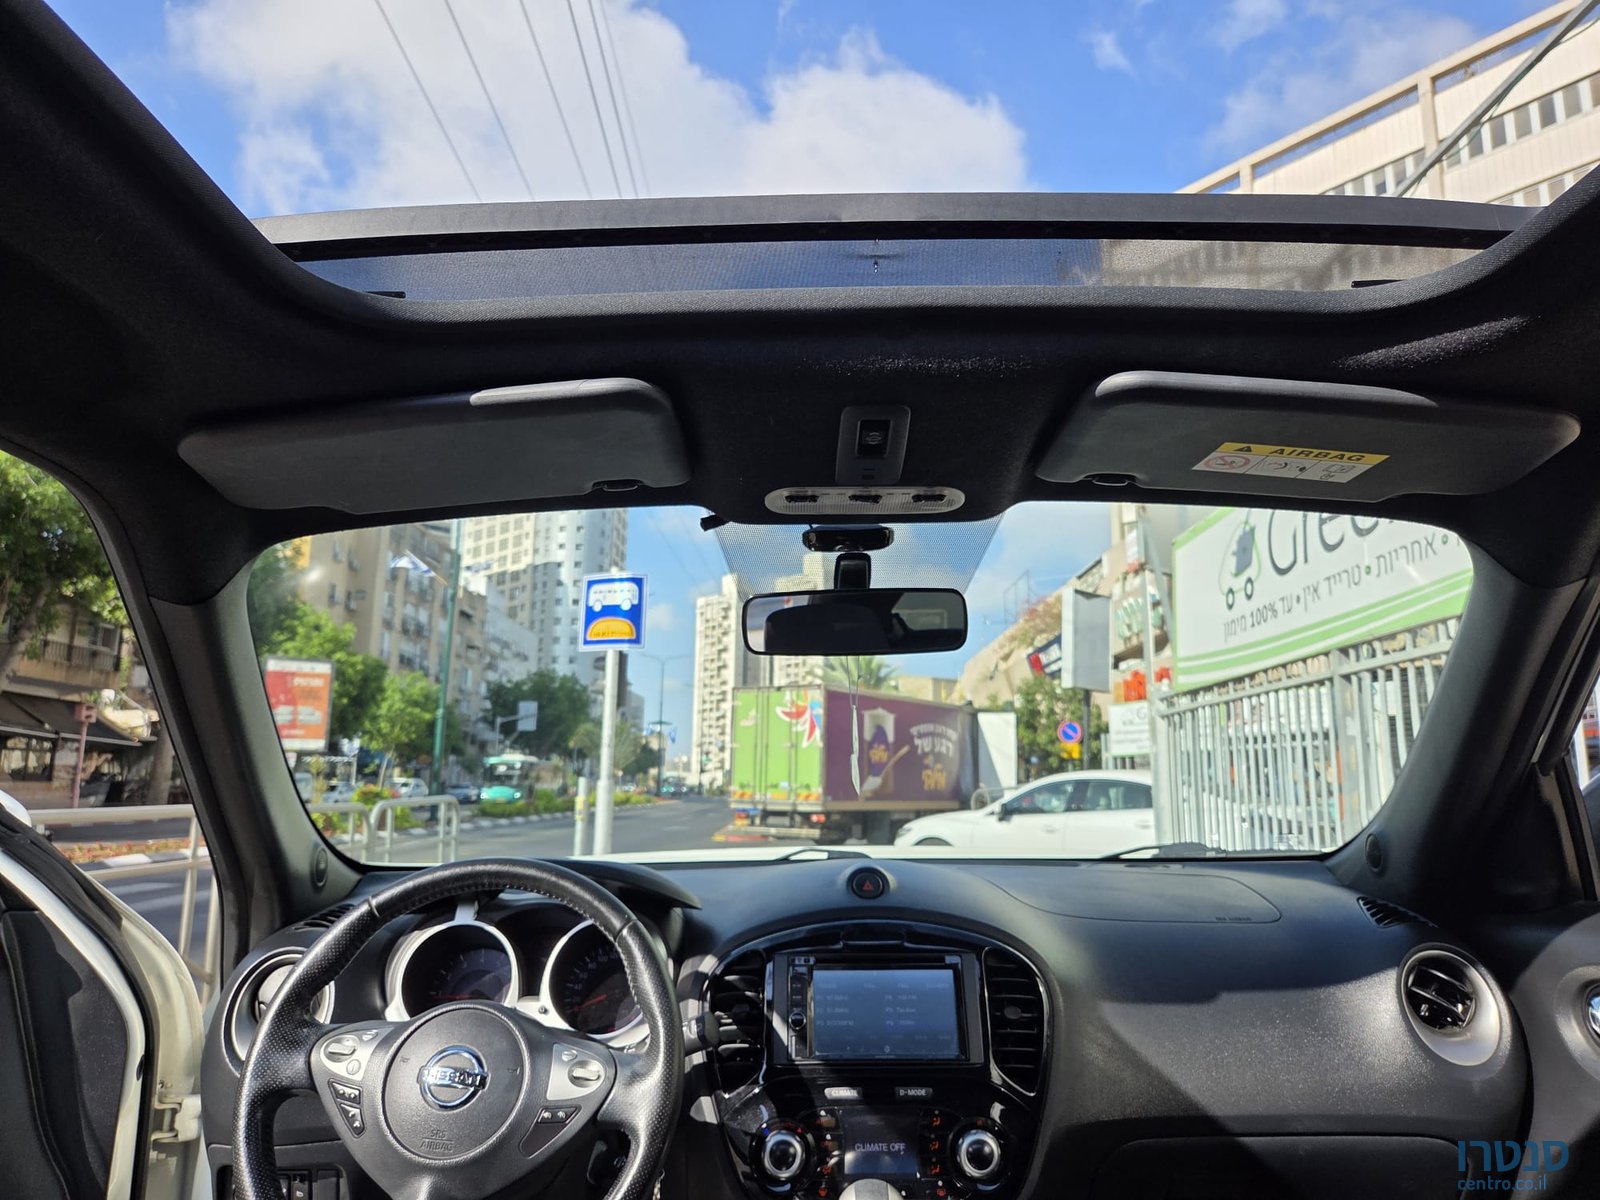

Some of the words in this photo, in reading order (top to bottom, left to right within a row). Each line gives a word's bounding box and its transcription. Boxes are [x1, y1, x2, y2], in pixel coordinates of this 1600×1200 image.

[1270, 448, 1366, 462] AIRBAG
[1375, 532, 1438, 578] אחריות
[1323, 563, 1362, 597] טרייד
[1278, 593, 1294, 615] עד
[1249, 600, 1279, 628] 100%
[1223, 613, 1248, 644] מימון
[899, 1088, 927, 1097] D-MODE
[430, 1128, 447, 1139] SRS
[419, 1139, 455, 1152] AIRBAG
[854, 1142, 889, 1153] CLIMATE
[890, 1142, 907, 1153] OFF
